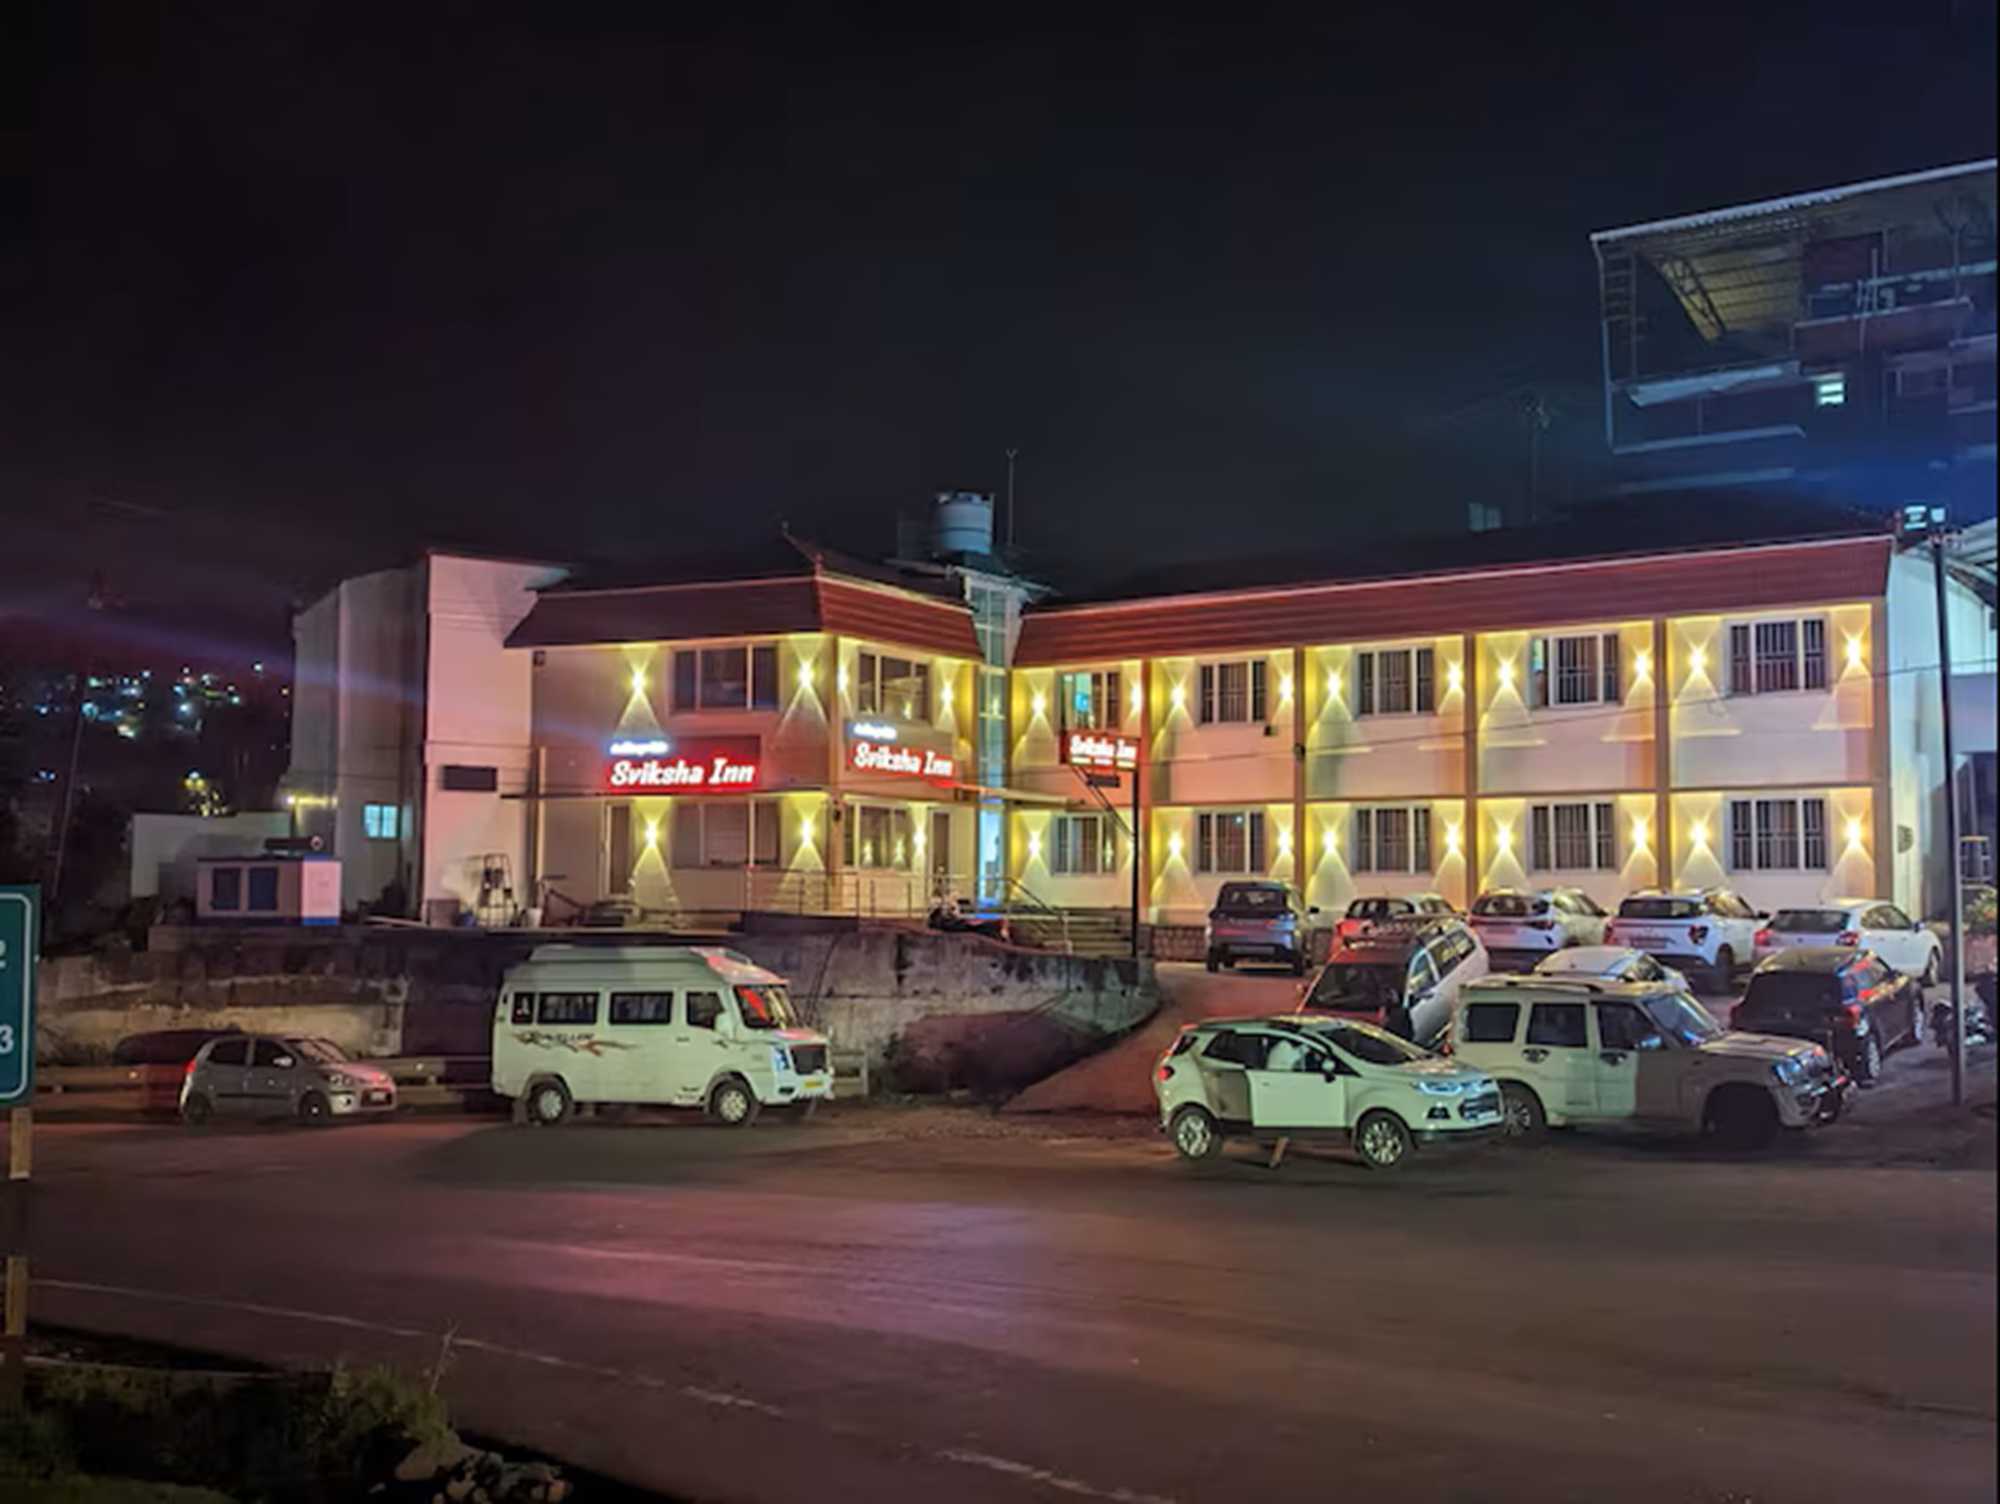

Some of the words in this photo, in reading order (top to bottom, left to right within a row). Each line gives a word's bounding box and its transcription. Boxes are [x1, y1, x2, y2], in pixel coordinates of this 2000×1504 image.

[610, 759, 704, 785] Sviksha
[708, 757, 755, 784] Inn
[854, 742, 921, 772] Sviksha
[923, 749, 954, 777] Inn
